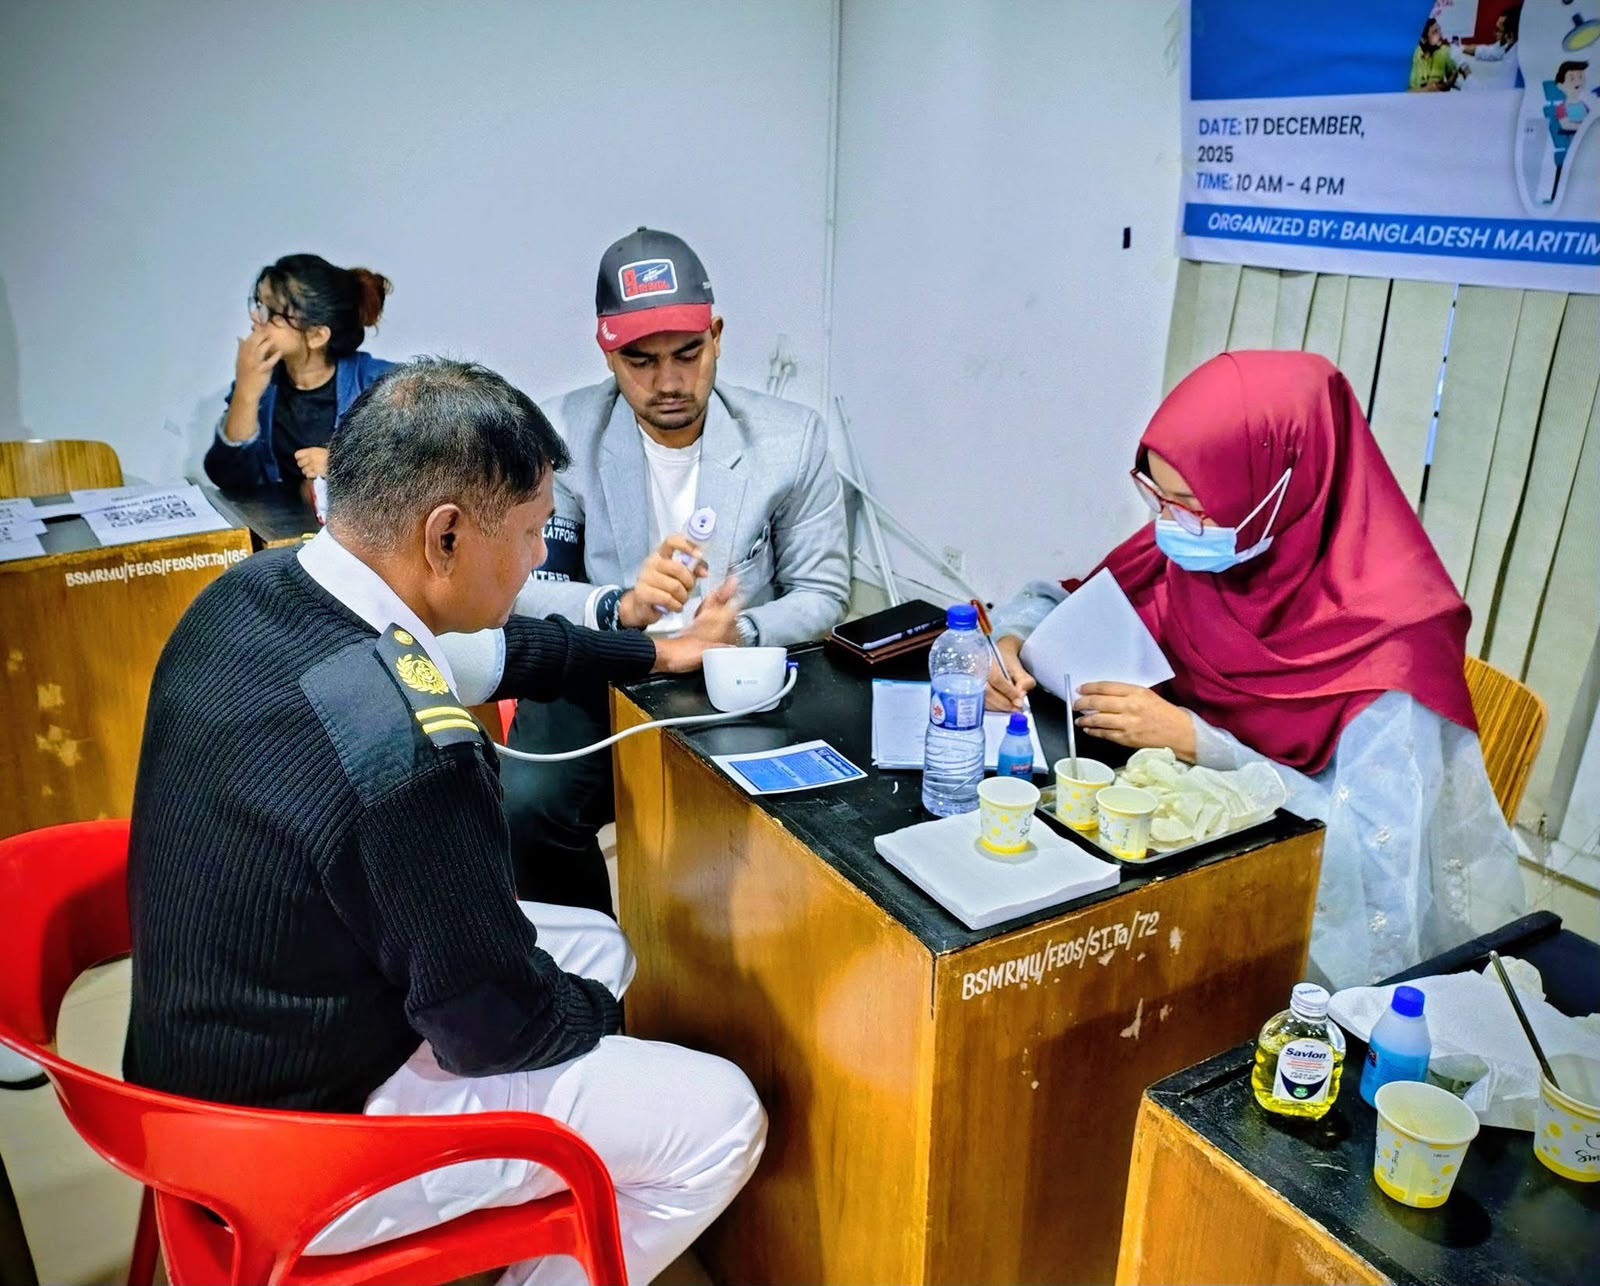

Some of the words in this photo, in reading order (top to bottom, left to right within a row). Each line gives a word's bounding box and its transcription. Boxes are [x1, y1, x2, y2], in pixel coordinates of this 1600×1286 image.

[1199, 118, 1241, 136] DATE:
[1245, 118, 1259, 136] 17
[1263, 115, 1365, 138] DECEMBER,
[1197, 145, 1233, 163] 2025
[1196, 172, 1232, 191] TIME:
[1236, 174, 1252, 191] 10
[1254, 175, 1283, 193] AM
[1300, 176, 1312, 194] 4
[1315, 177, 1345, 195] PM
[1207, 212, 1305, 237] ORGANIZED
[1307, 219, 1337, 240] BY:
[1340, 221, 1492, 249] BANGLADESH
[1285, 1047, 1327, 1060] Savlon
